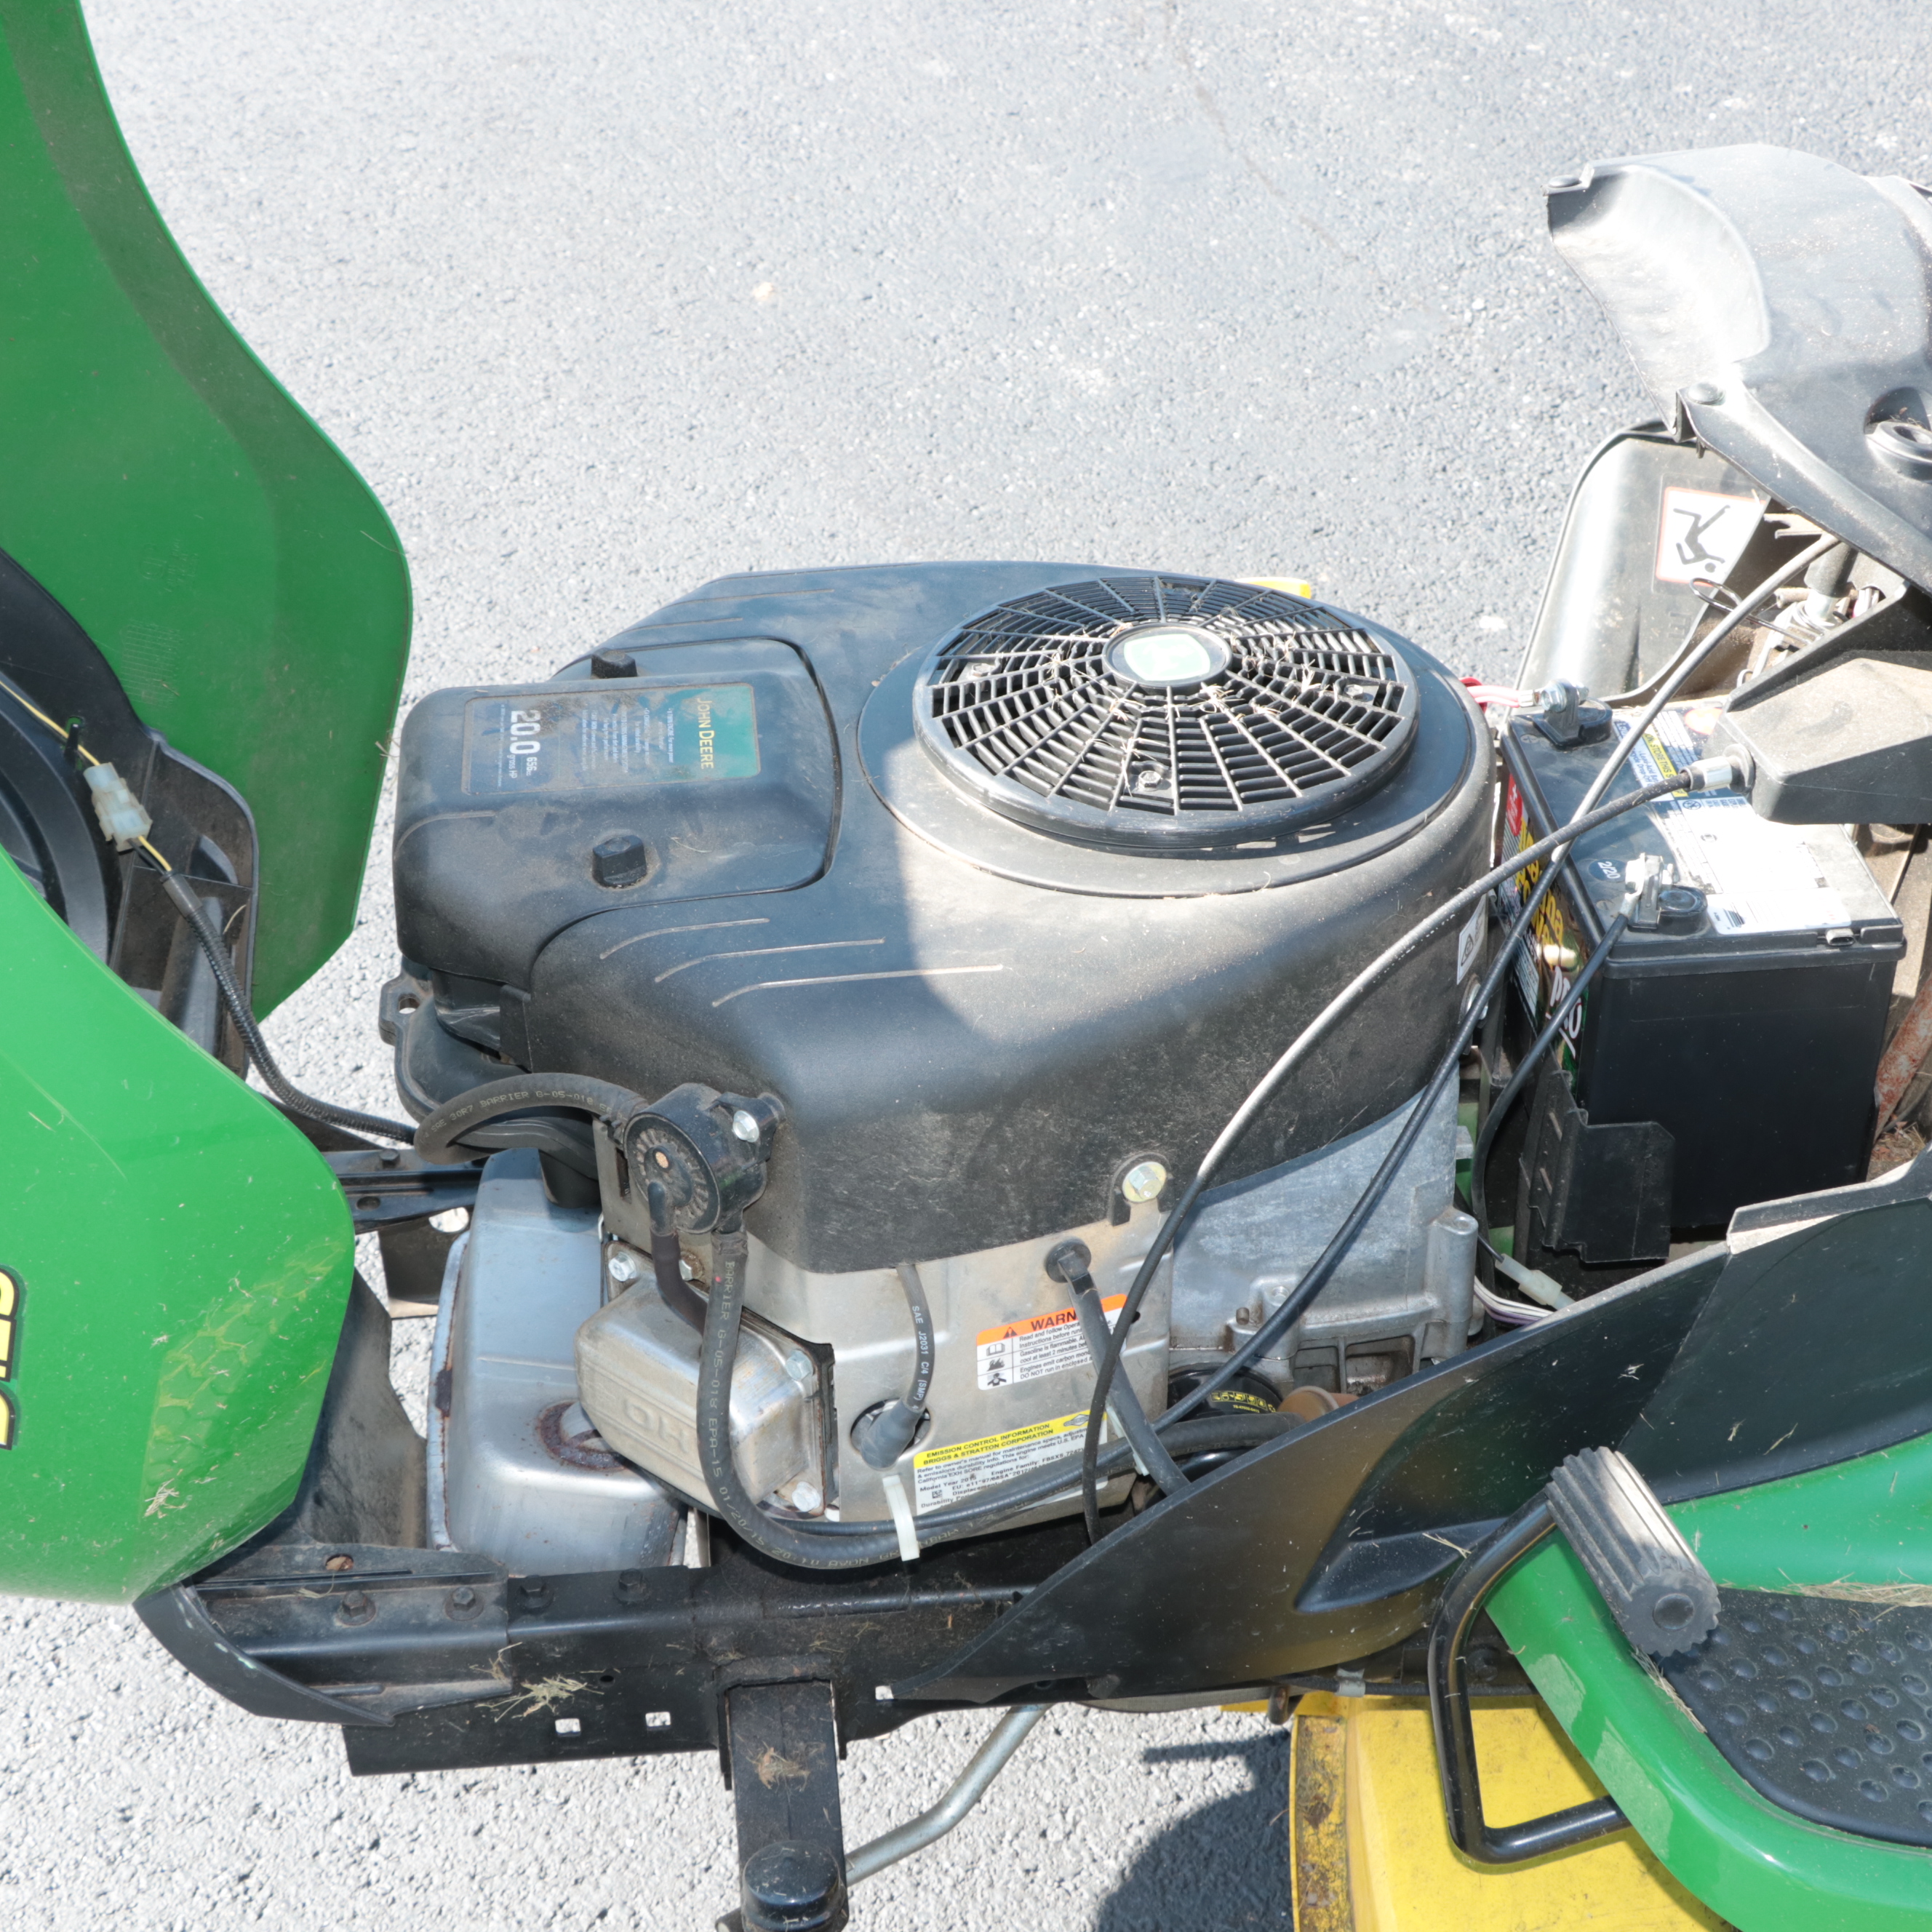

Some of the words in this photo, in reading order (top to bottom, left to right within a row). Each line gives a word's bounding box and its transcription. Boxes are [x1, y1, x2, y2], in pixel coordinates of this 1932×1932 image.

[696, 697, 713, 727] JOHN
[509, 709, 540, 754] 20.0
[698, 730, 716, 769] DEERE
[1650, 742, 1664, 762] STORE
[1659, 759, 1671, 774] THIS
[1596, 860, 1620, 880] 2/20
[429, 1118, 447, 1133] SAE
[449, 1103, 474, 1121] 30R7
[479, 1090, 529, 1109] BARRIER
[535, 1090, 594, 1104] G-05-018
[719, 1260, 735, 1320] BARRIER
[911, 1304, 923, 1324] SAE
[1030, 1310, 1077, 1330] WARN
[917, 1330, 929, 1354] J2031
[1018, 1333, 1033, 1341] Read
[1045, 1325, 1063, 1334] follow
[1063, 1321, 1079, 1330] Opera
[1018, 1336, 1052, 1349] Instructions
[1052, 1330, 1070, 1339] before
[1019, 1346, 1043, 1357] Gasoline
[1049, 1337, 1077, 1349] flammable.
[1056, 1344, 1077, 1353] minutes
[709, 1329, 726, 1409] G-05-018
[919, 1360, 930, 1374] C/4
[1019, 1362, 1042, 1373] Engines
[1055, 1354, 1074, 1363] carbon
[1030, 1368, 1043, 1376] NOT
[1061, 1357, 1088, 1368] enclosed
[913, 1378, 927, 1401] (SMP)
[618, 1397, 690, 1452] OH
[708, 1418, 725, 1478] EPA-15
[917, 1466, 933, 1474] Refer
[943, 1458, 967, 1468] owner's
[968, 1453, 991, 1462] manual
[1002, 1440, 1041, 1453] maintenance
[1042, 1434, 1062, 1444] specs,
[1063, 1427, 1088, 1438] adjustm
[922, 1454, 951, 1465] BRIGGS
[961, 1443, 999, 1456] STRATTON
[1002, 1429, 1053, 1445] CORPORATION
[926, 1445, 962, 1458] EMISSION
[963, 1437, 998, 1449] CONTROL
[999, 1424, 1050, 1440] INFORMATION
[917, 1473, 947, 1485] California
[963, 1465, 982, 1474] SORE
[983, 1456, 1017, 1470] regulations
[919, 1483, 941, 1493] Model
[991, 1466, 1013, 1476] Engine
[1015, 1459, 1040, 1469] Family:
[1041, 1447, 1085, 1462] FBSXS.7242V
[923, 1466, 955, 1478] emissions
[957, 1459, 986, 1471] durability
[1015, 1446, 1037, 1456] engine
[1037, 1441, 1056, 1450] meets
[717, 1485, 765, 1547] 01/20/15
[920, 1496, 954, 1509] Durability
